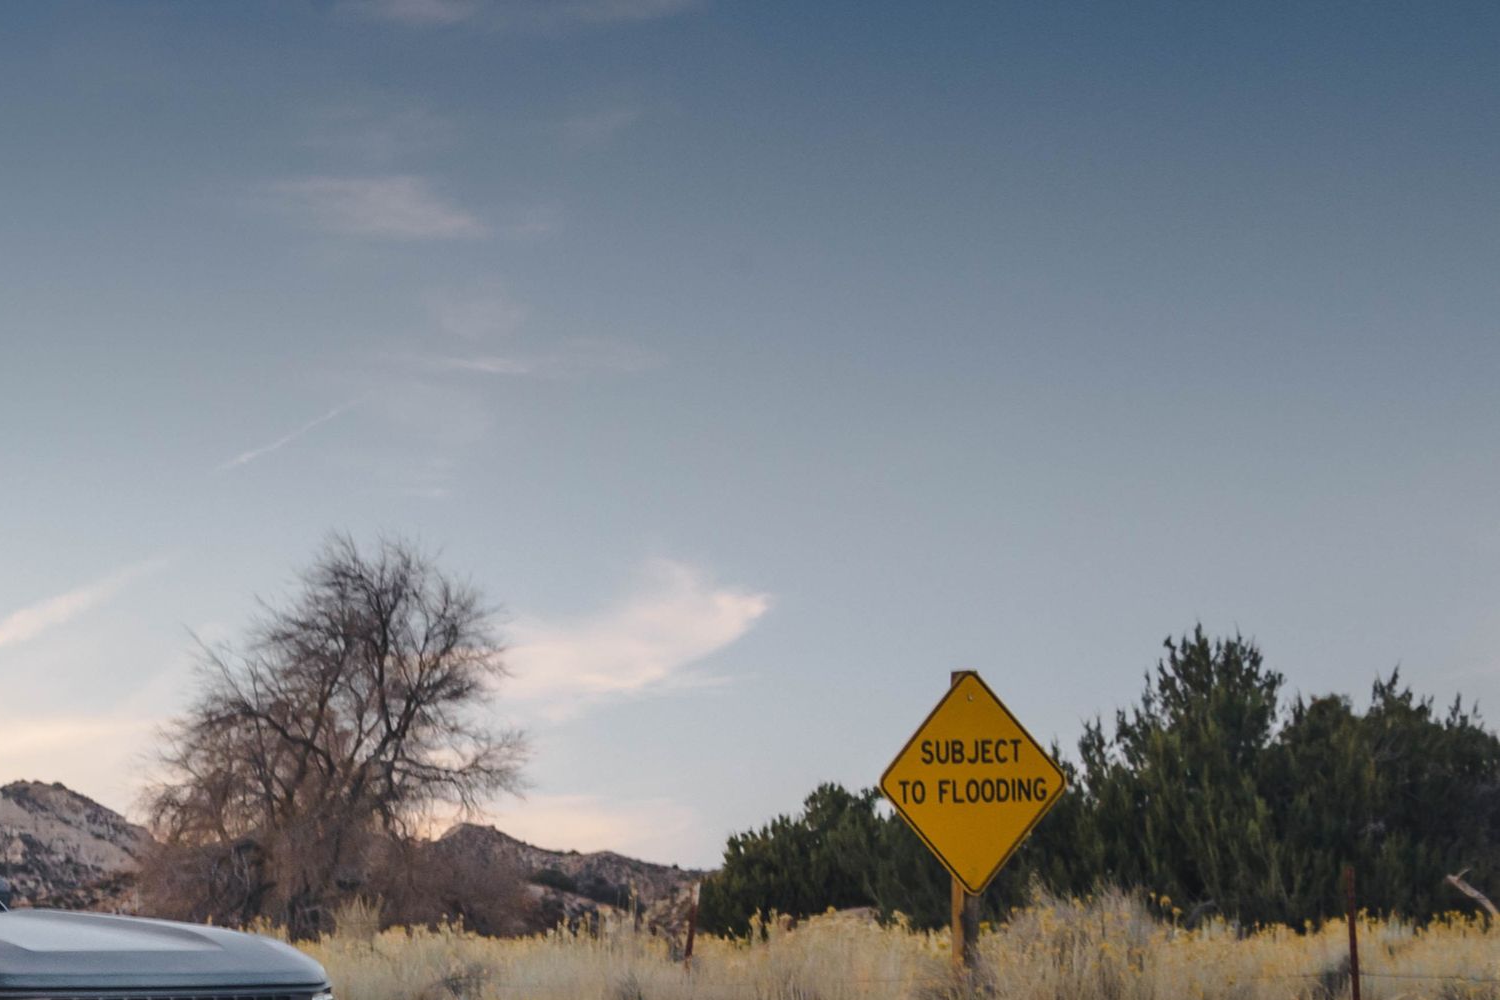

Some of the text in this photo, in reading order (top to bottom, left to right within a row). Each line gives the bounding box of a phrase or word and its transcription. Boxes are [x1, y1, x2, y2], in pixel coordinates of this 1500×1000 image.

[921, 739, 1021, 764] SUBJECT
[899, 777, 1047, 804] TO FLOODING
